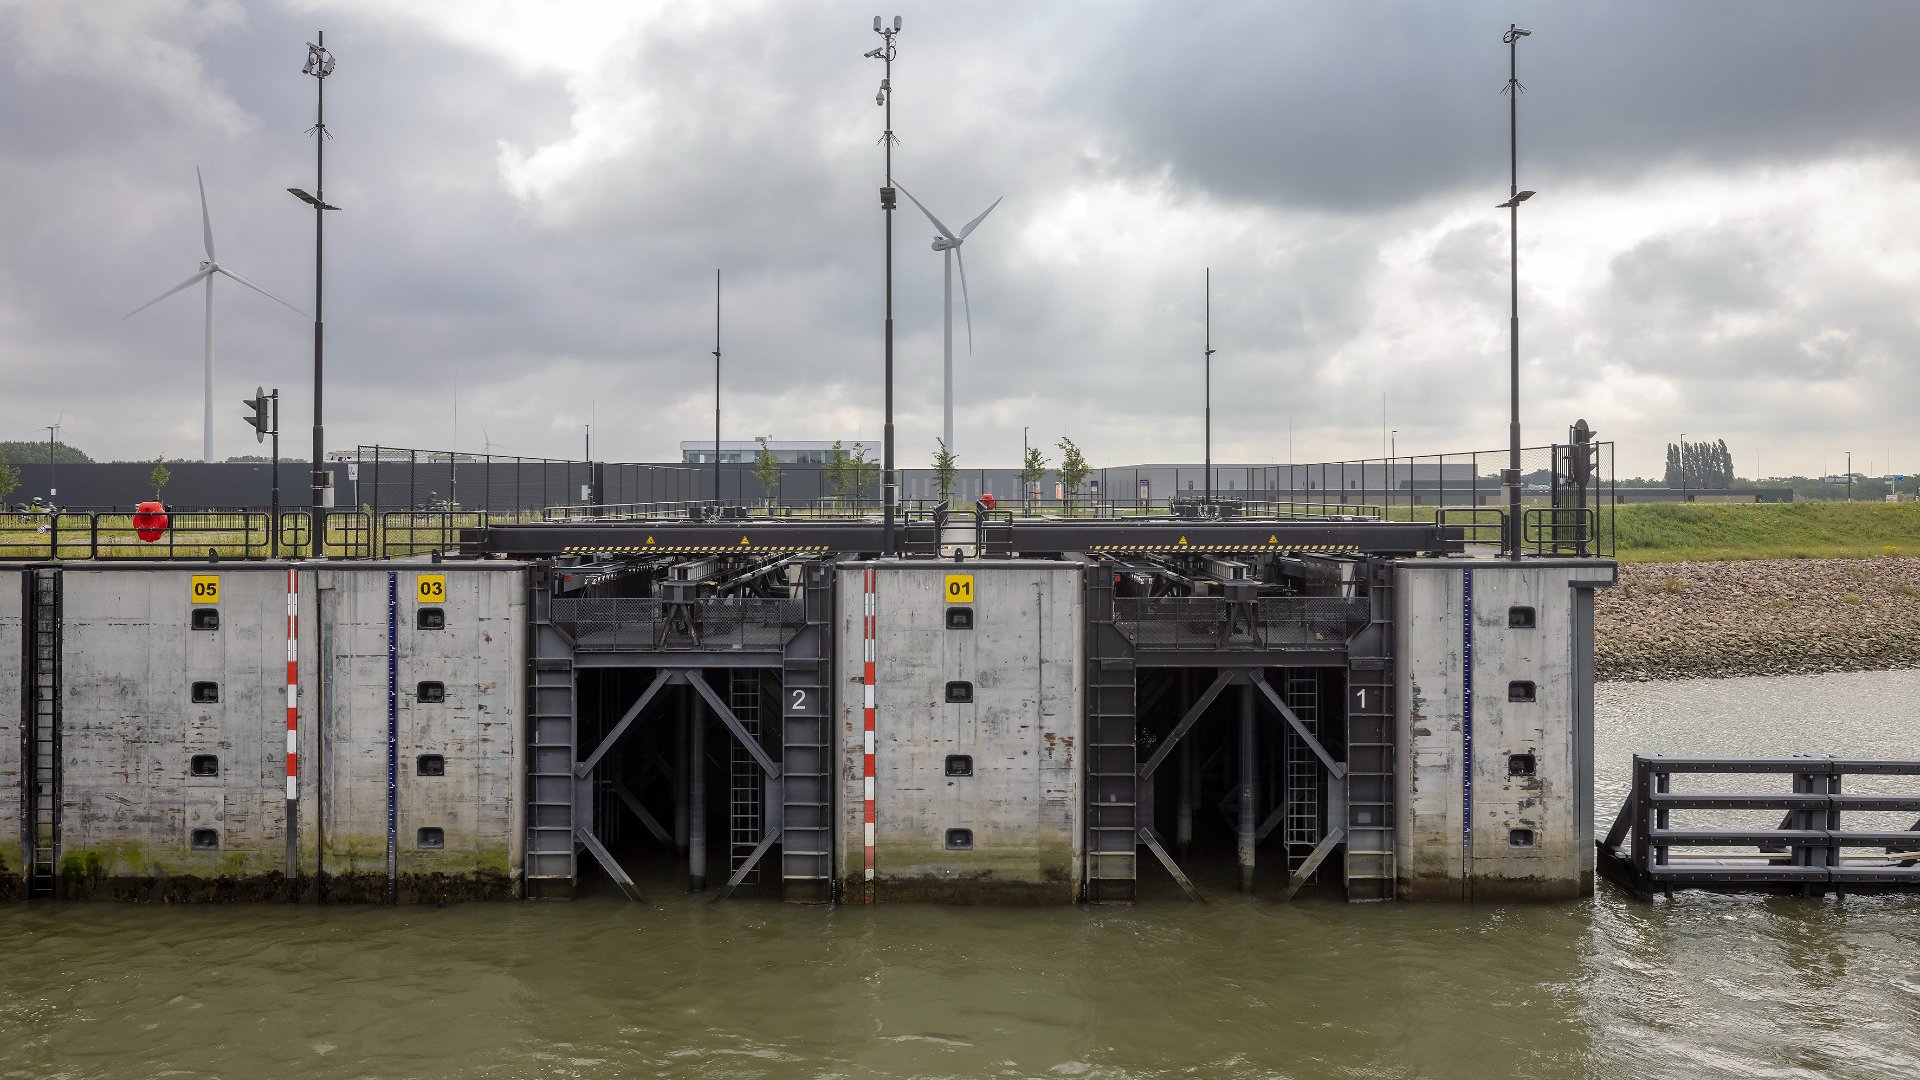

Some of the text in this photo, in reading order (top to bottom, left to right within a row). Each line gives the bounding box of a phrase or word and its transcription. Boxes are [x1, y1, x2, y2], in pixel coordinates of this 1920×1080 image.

[195, 583, 216, 596] 05
[420, 582, 442, 595] 03
[950, 582, 970, 595] 01
[792, 690, 806, 710] 2
[1356, 688, 1366, 708] 1
